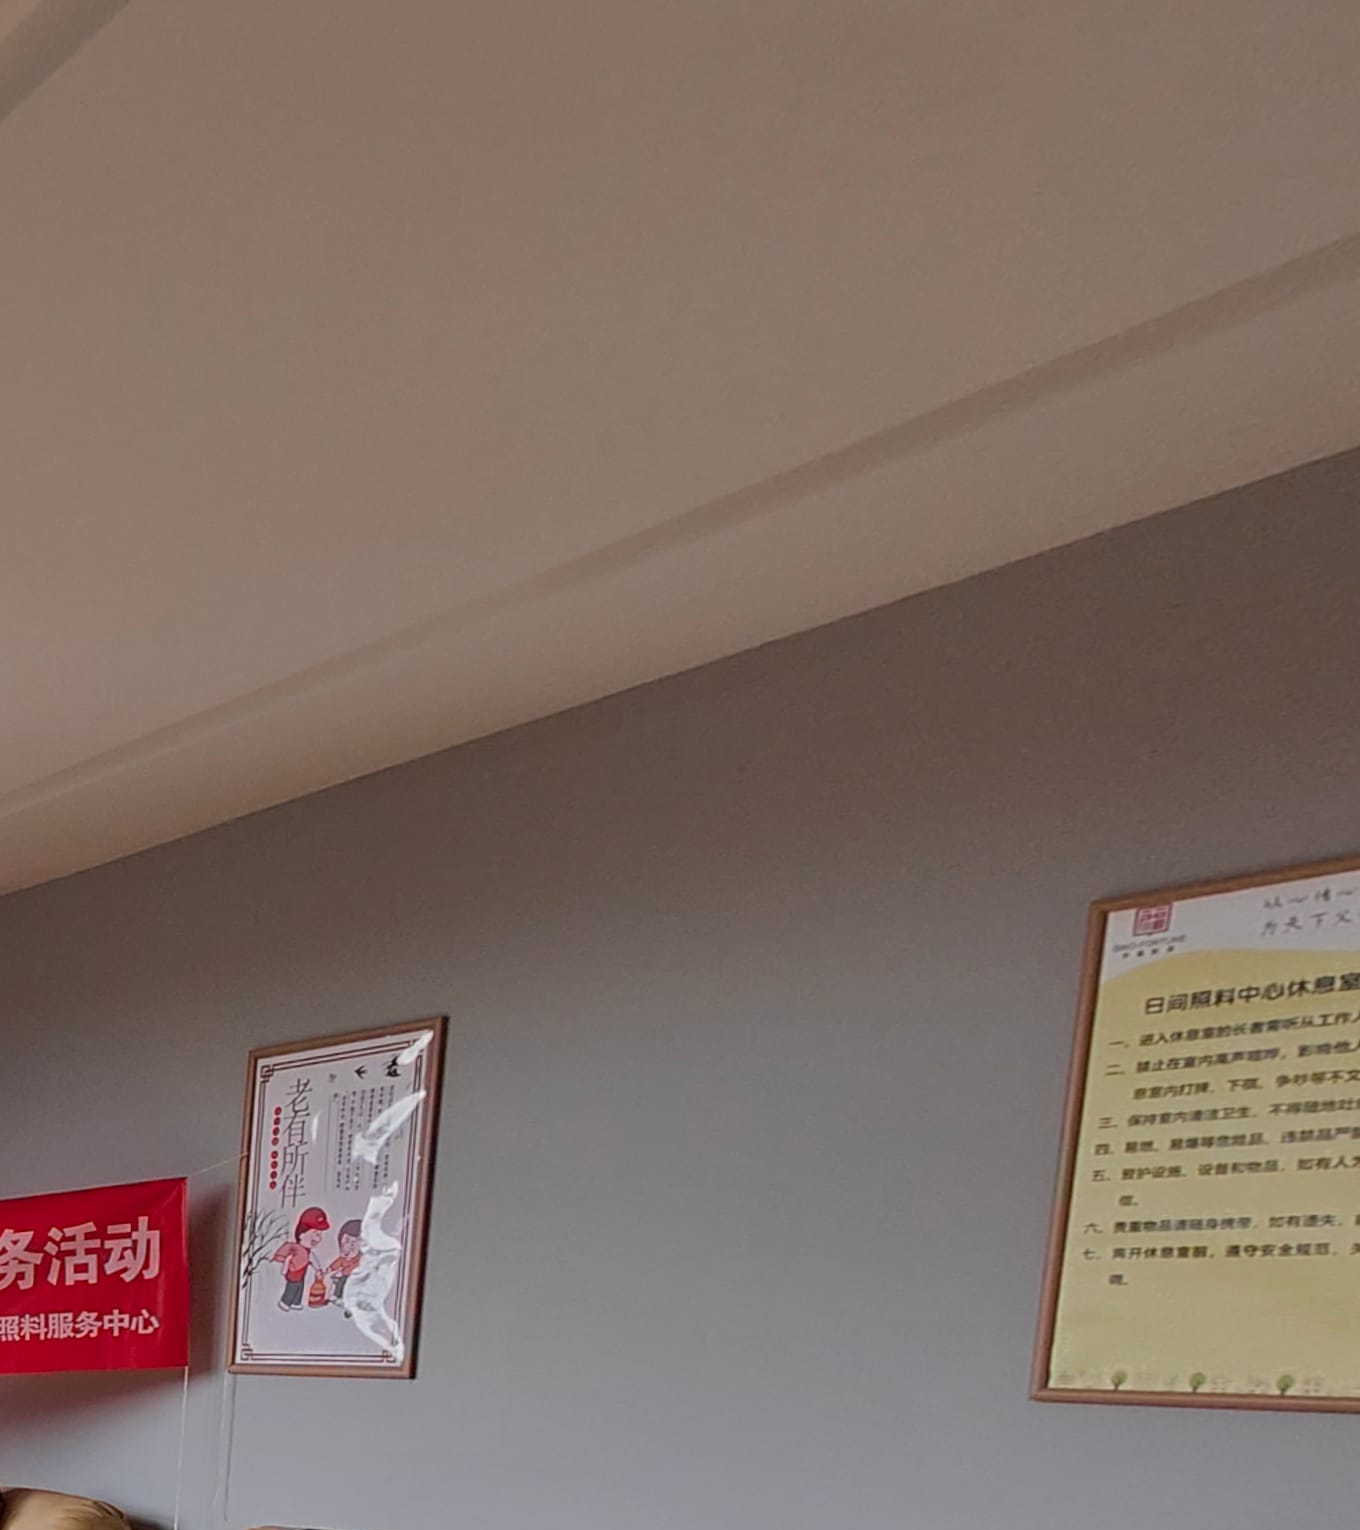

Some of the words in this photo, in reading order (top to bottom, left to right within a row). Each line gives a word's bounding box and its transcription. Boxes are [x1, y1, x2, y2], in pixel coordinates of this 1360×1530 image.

[1259, 910, 1360, 937] 为天下父
[1144, 972, 1360, 1015] 日间照料中心休息室
[280, 1077, 313, 1209] 老有所伴
